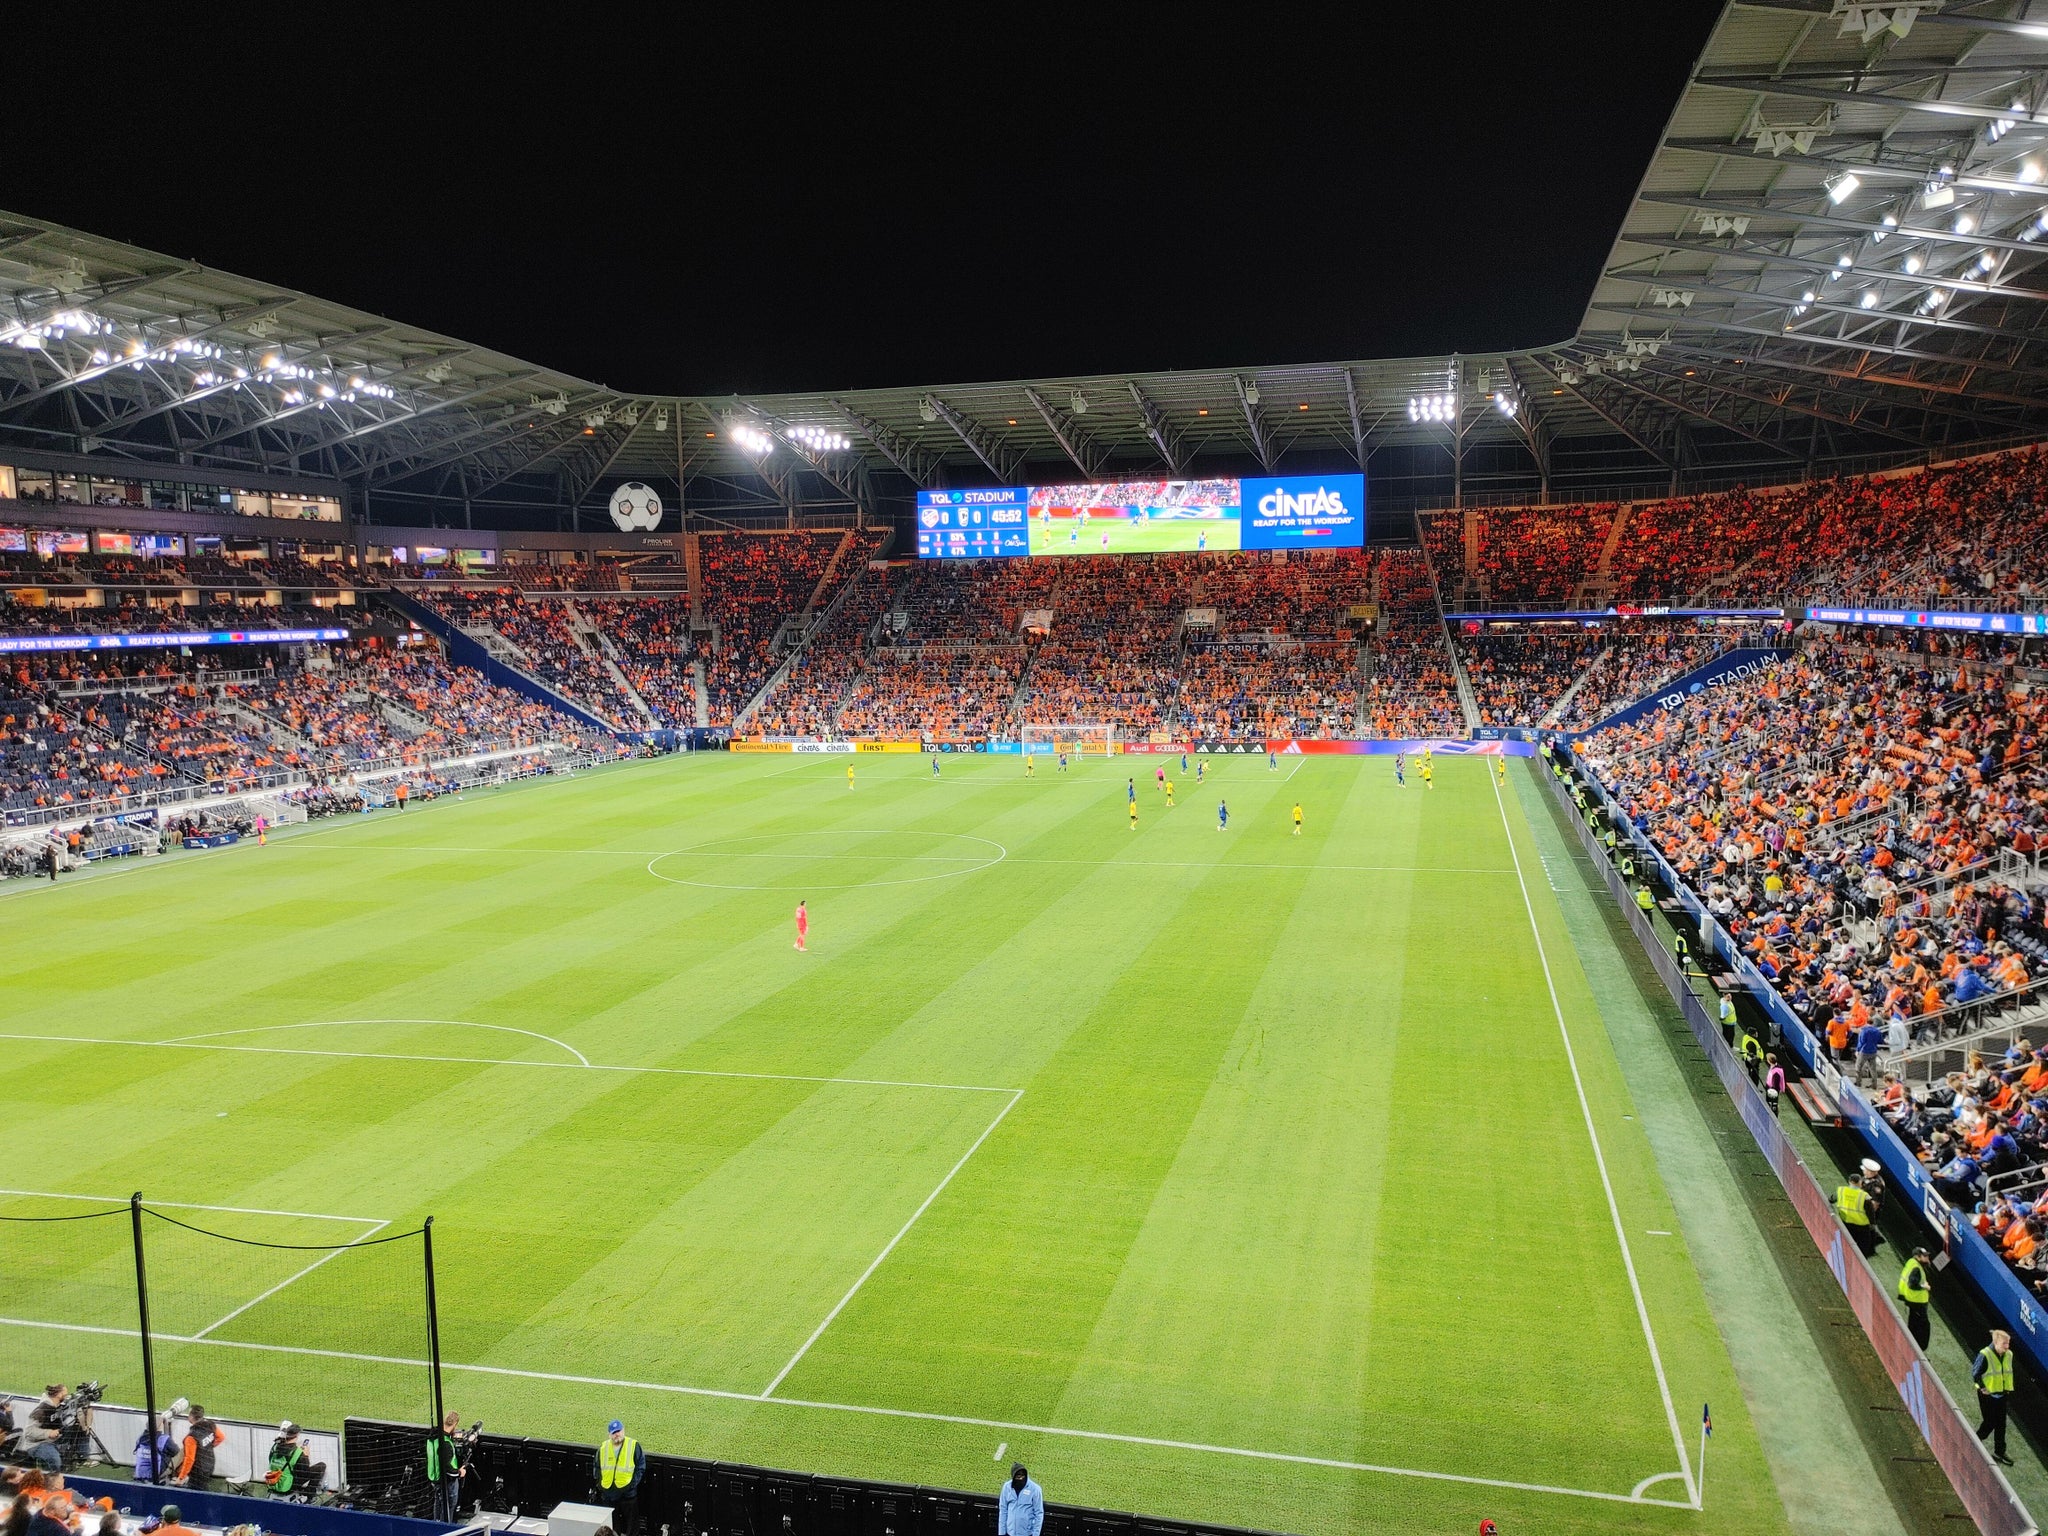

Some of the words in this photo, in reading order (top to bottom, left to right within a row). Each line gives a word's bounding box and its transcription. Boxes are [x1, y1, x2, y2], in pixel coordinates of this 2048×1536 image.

[930, 494, 952, 504] TQL
[965, 492, 1015, 503] STADIUM
[942, 512, 949, 525] 0
[974, 511, 981, 524] 0
[992, 510, 1022, 523] 45:52
[1253, 519, 1279, 527] READY
[1314, 516, 1352, 525] WORKDAY
[1644, 607, 1670, 615] LIGHT
[20, 641, 35, 649] FOR
[37, 640, 51, 648] THE
[53, 639, 89, 648] WORKDAY
[152, 637, 165, 645] FOR
[1707, 652, 1780, 686] STADIUM
[923, 744, 942, 752] TQL
[955, 744, 975, 752] TQL
[124, 811, 153, 822] STADIUM
[2020, 1299, 2031, 1320] TQL
